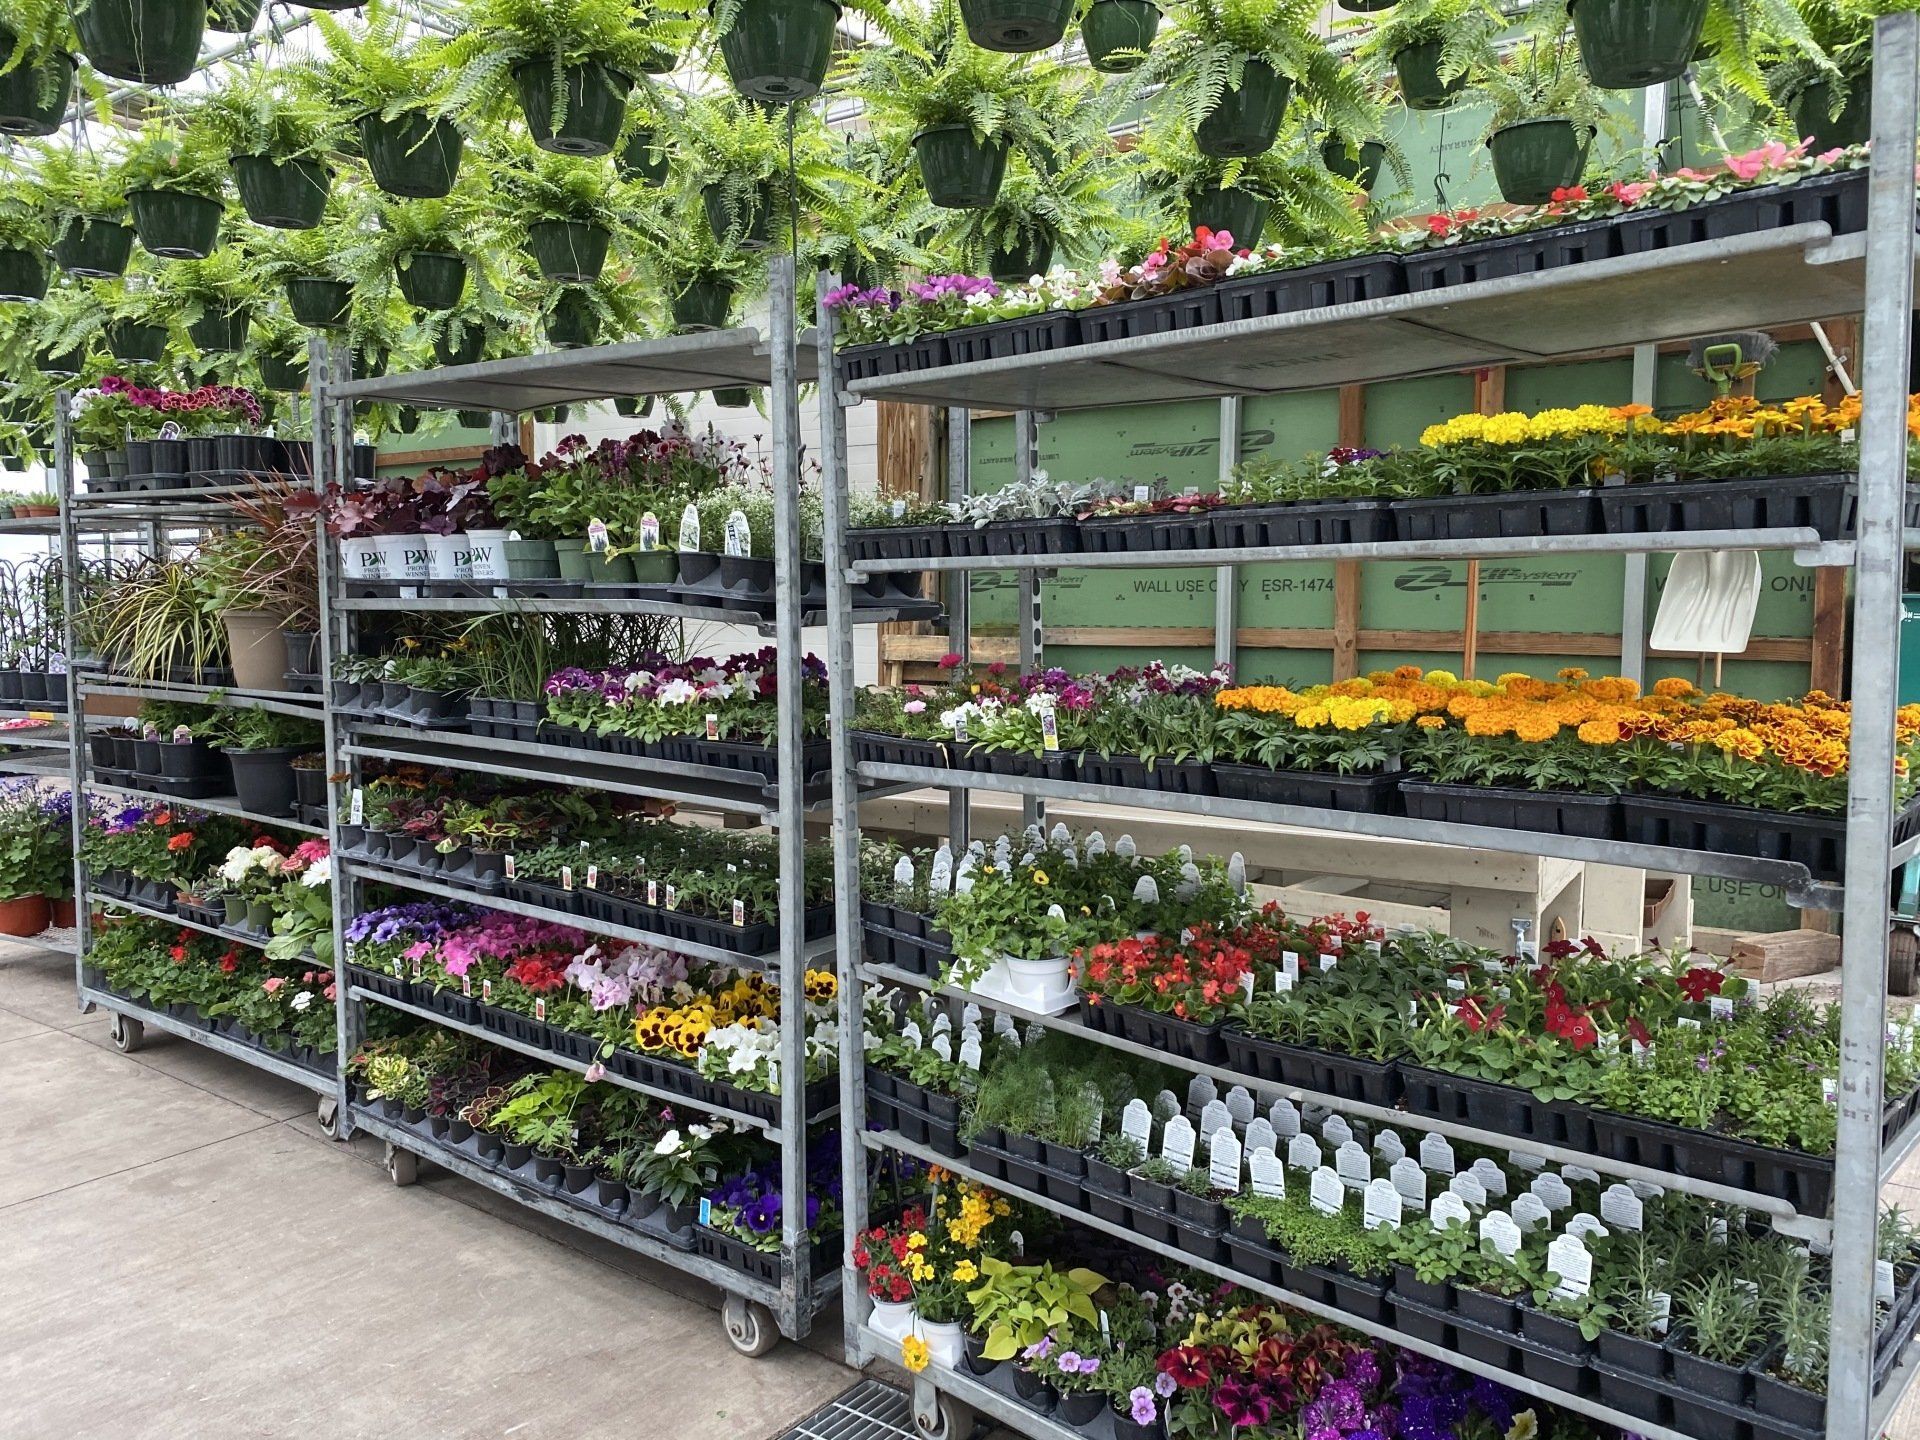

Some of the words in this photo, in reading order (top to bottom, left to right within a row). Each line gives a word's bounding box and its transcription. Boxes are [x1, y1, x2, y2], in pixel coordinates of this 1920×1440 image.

[1133, 579, 1172, 593] WALL
[1176, 579, 1205, 593] USE
[1208, 579, 1249, 593] OY
[1261, 578, 1335, 592] ESR-1474
[1771, 576, 1815, 592] ONL
[1708, 877, 1751, 896] USE
